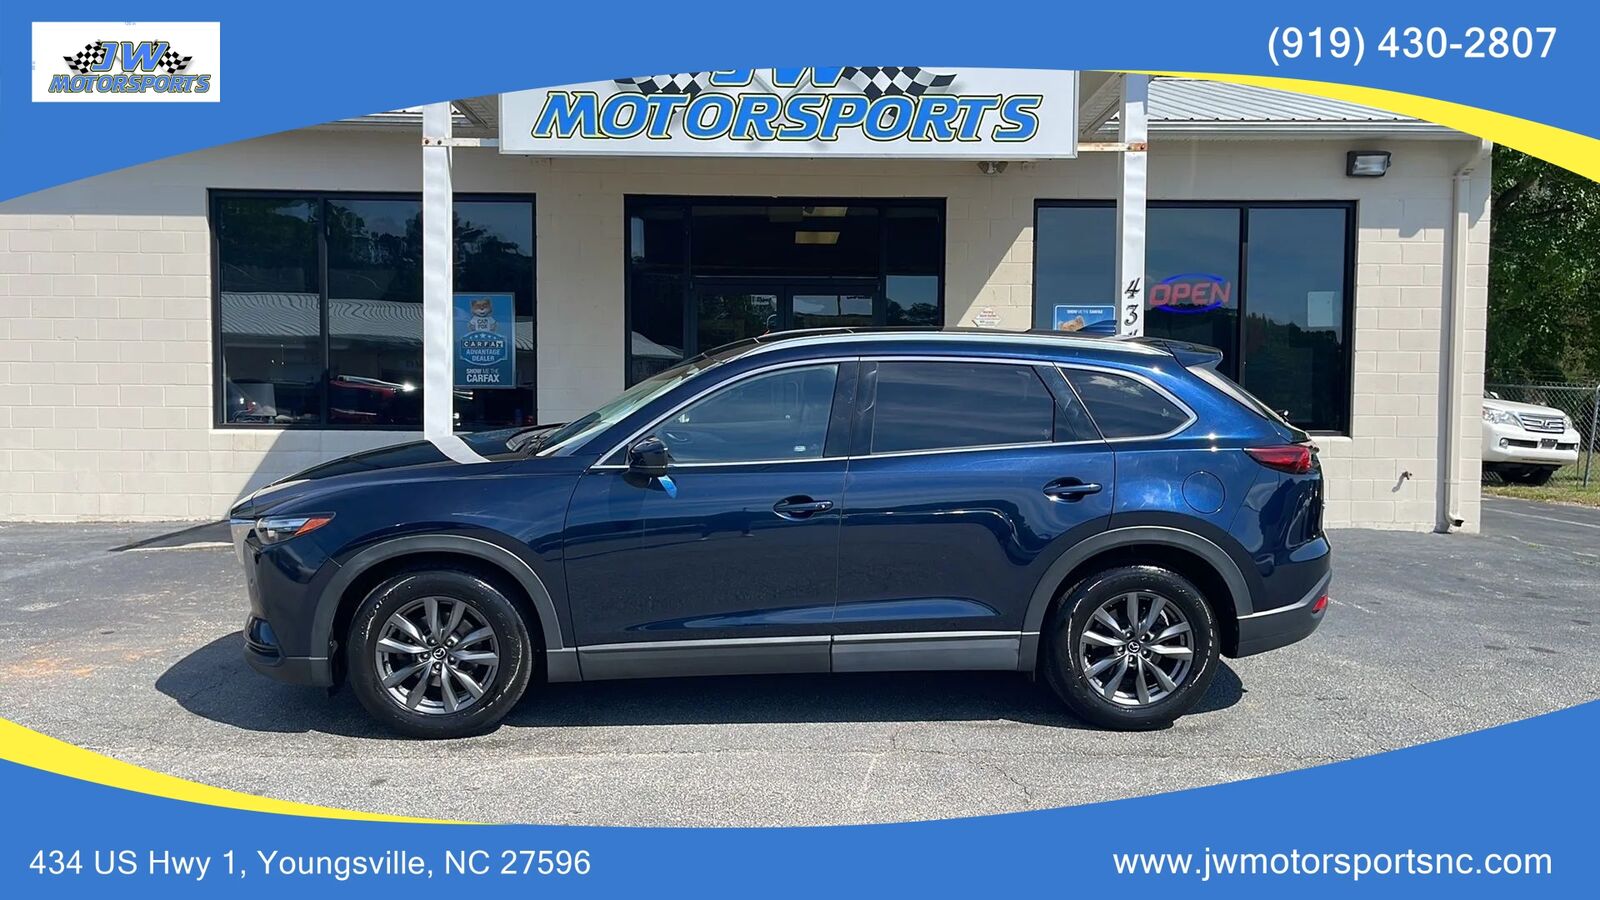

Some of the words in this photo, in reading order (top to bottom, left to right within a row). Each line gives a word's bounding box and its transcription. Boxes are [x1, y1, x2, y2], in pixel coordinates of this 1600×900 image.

[530, 90, 1043, 142] MOTORSPORTS
[1124, 278, 1141, 336] 43
[1148, 281, 1232, 306] OPEN
[466, 374, 500, 383] CARFAX
